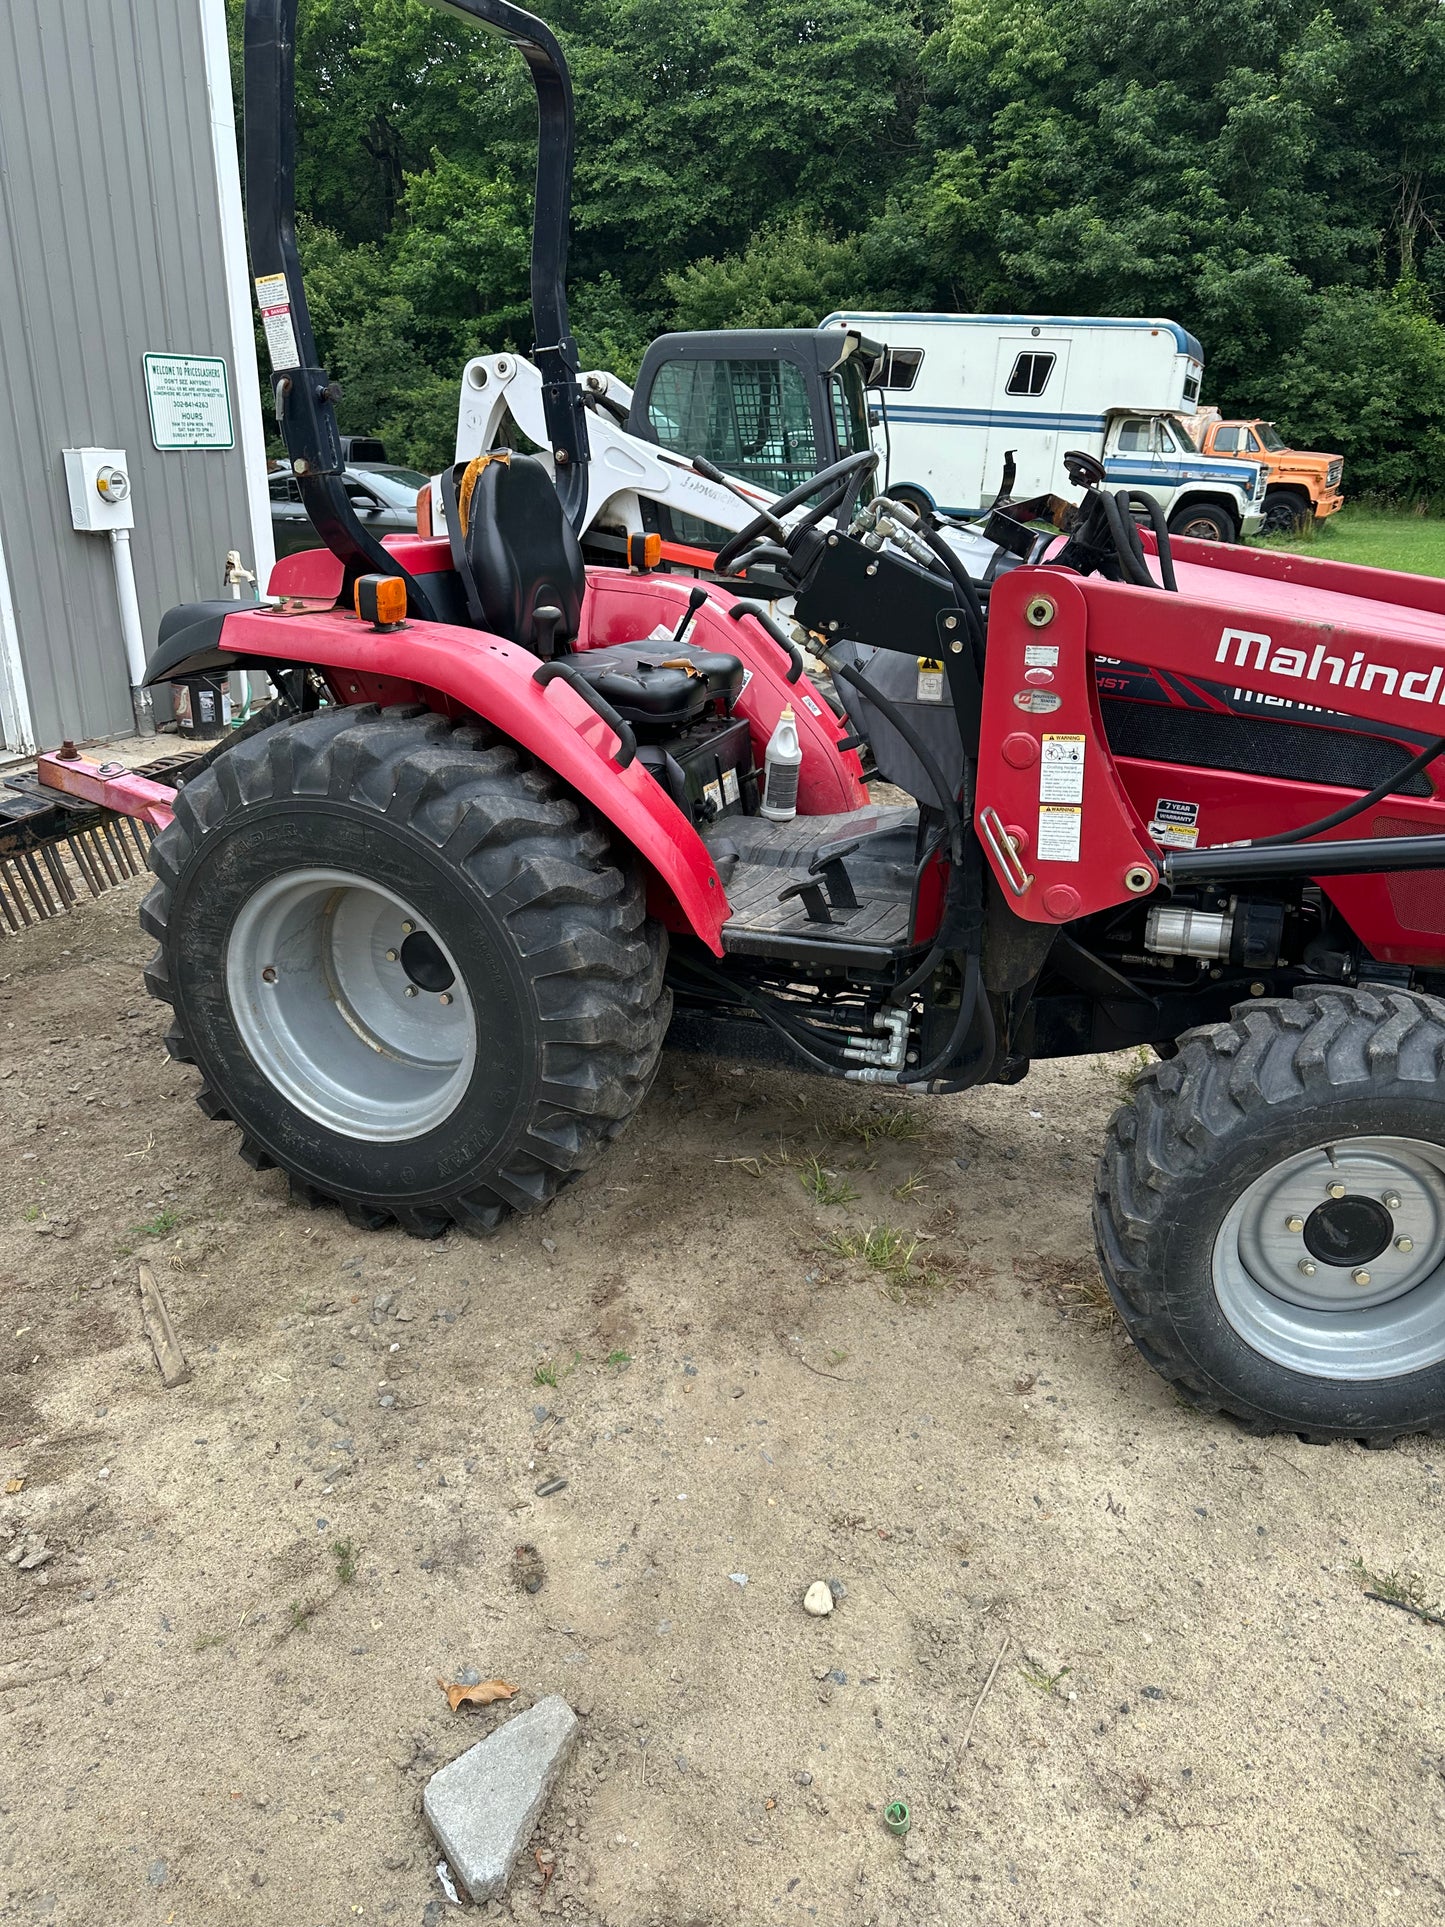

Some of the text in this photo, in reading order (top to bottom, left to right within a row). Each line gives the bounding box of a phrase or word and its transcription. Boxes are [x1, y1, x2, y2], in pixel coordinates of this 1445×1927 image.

[152, 365, 220, 378] WELCOME TO PRICESLASHERS
[1160, 813, 1192, 822] WARRANTY
[437, 1124, 495, 1178] TITAN
